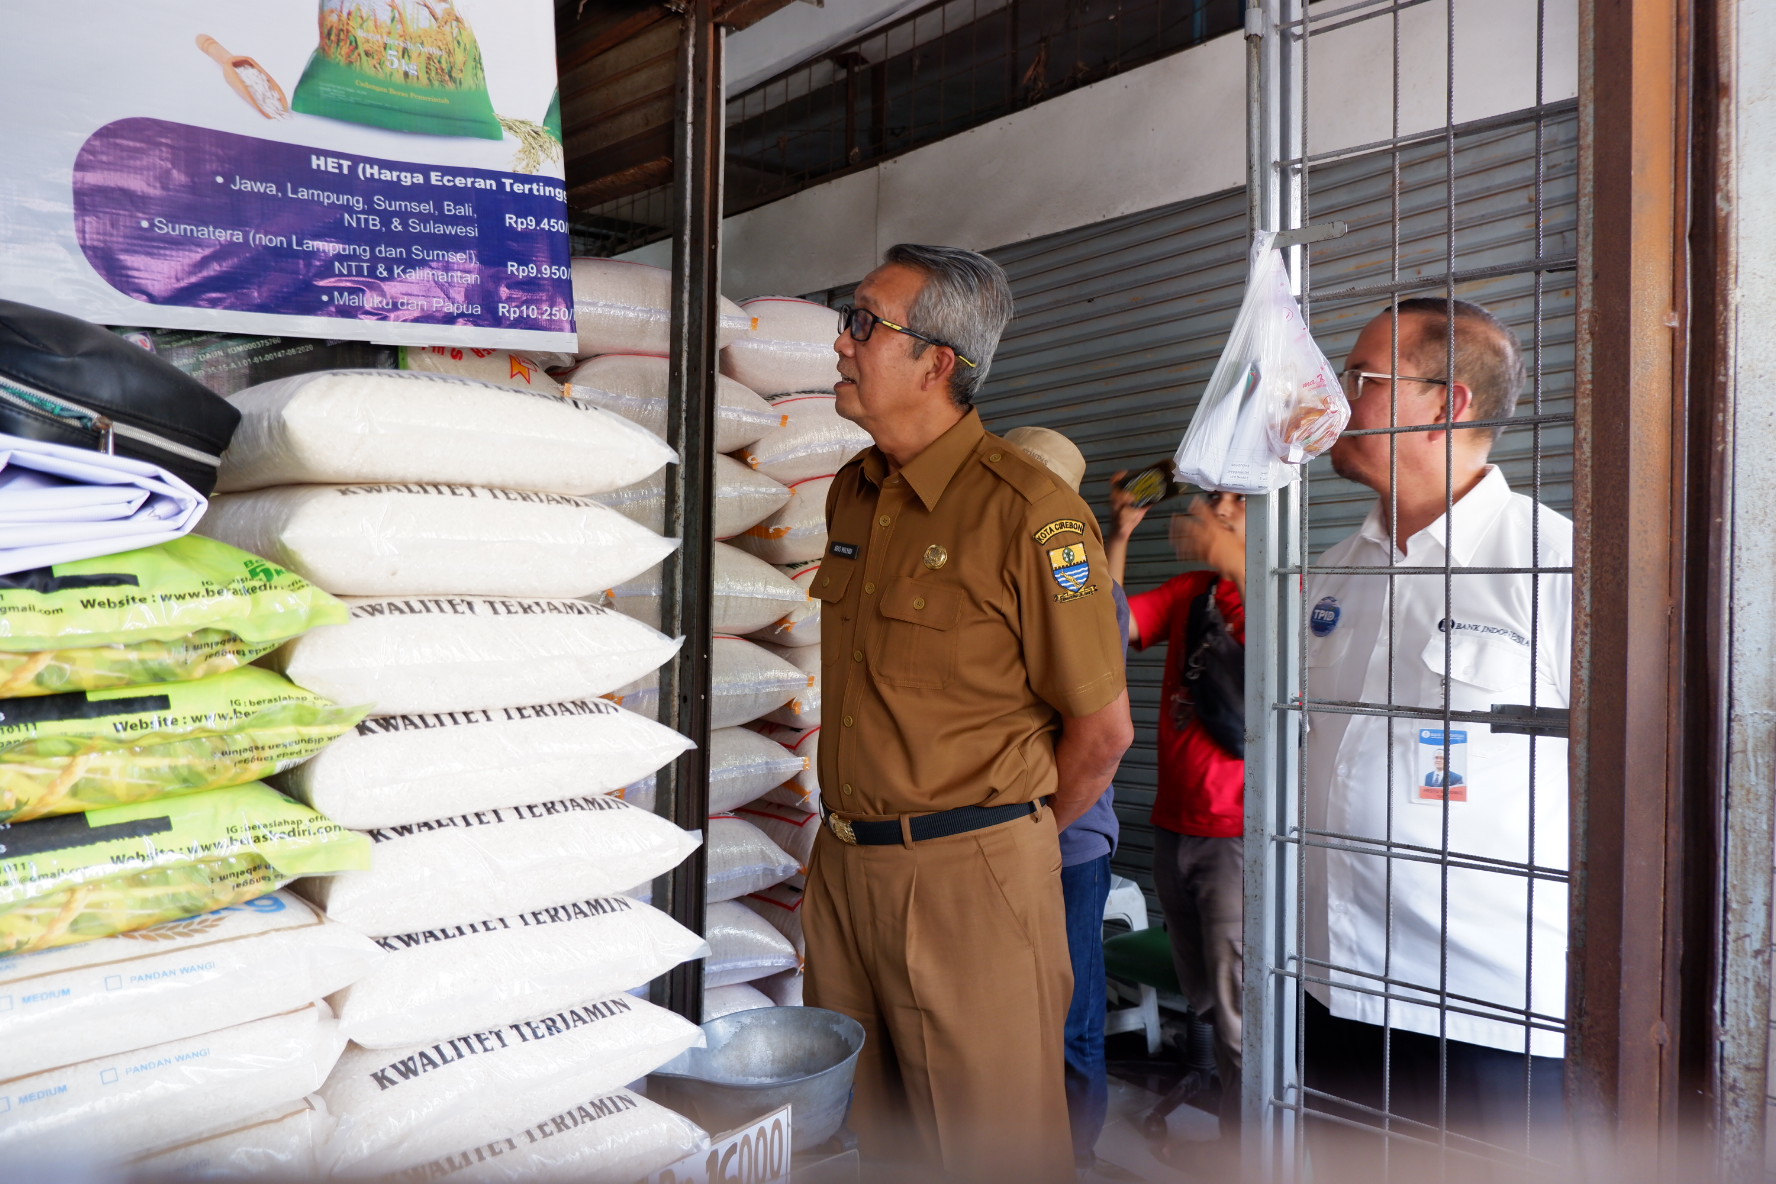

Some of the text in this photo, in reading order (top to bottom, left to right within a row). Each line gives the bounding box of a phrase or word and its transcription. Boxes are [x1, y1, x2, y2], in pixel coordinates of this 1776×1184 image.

[311, 154, 352, 175] HET
[358, 162, 424, 186] (Harga
[430, 171, 497, 191] Eceran
[230, 175, 477, 219] Jawa, Lampung, Sumsel, Bali,
[343, 212, 479, 237] NTB, & Sulawesi
[154, 217, 480, 265] Sumatera (non Lampung dan Sumsel),
[334, 261, 480, 285] NTT & Kalimantan
[334, 291, 481, 316] Maluku dan Papua
[1036, 521, 1084, 542] KOTA CIREBON
[247, 562, 275, 582] 5
[80, 595, 148, 610] Website
[1313, 609, 1335, 621] TPID
[1455, 622, 1480, 632] BANK
[112, 715, 179, 733] Website
[518, 897, 633, 927] TERJAMIN
[21, 961, 216, 1005] MEDIUM PANDAN WANGI
[370, 998, 632, 1091] KWALITET TERJAMIN
[17, 1048, 211, 1105] MEDIUM PANDAN WANGI
